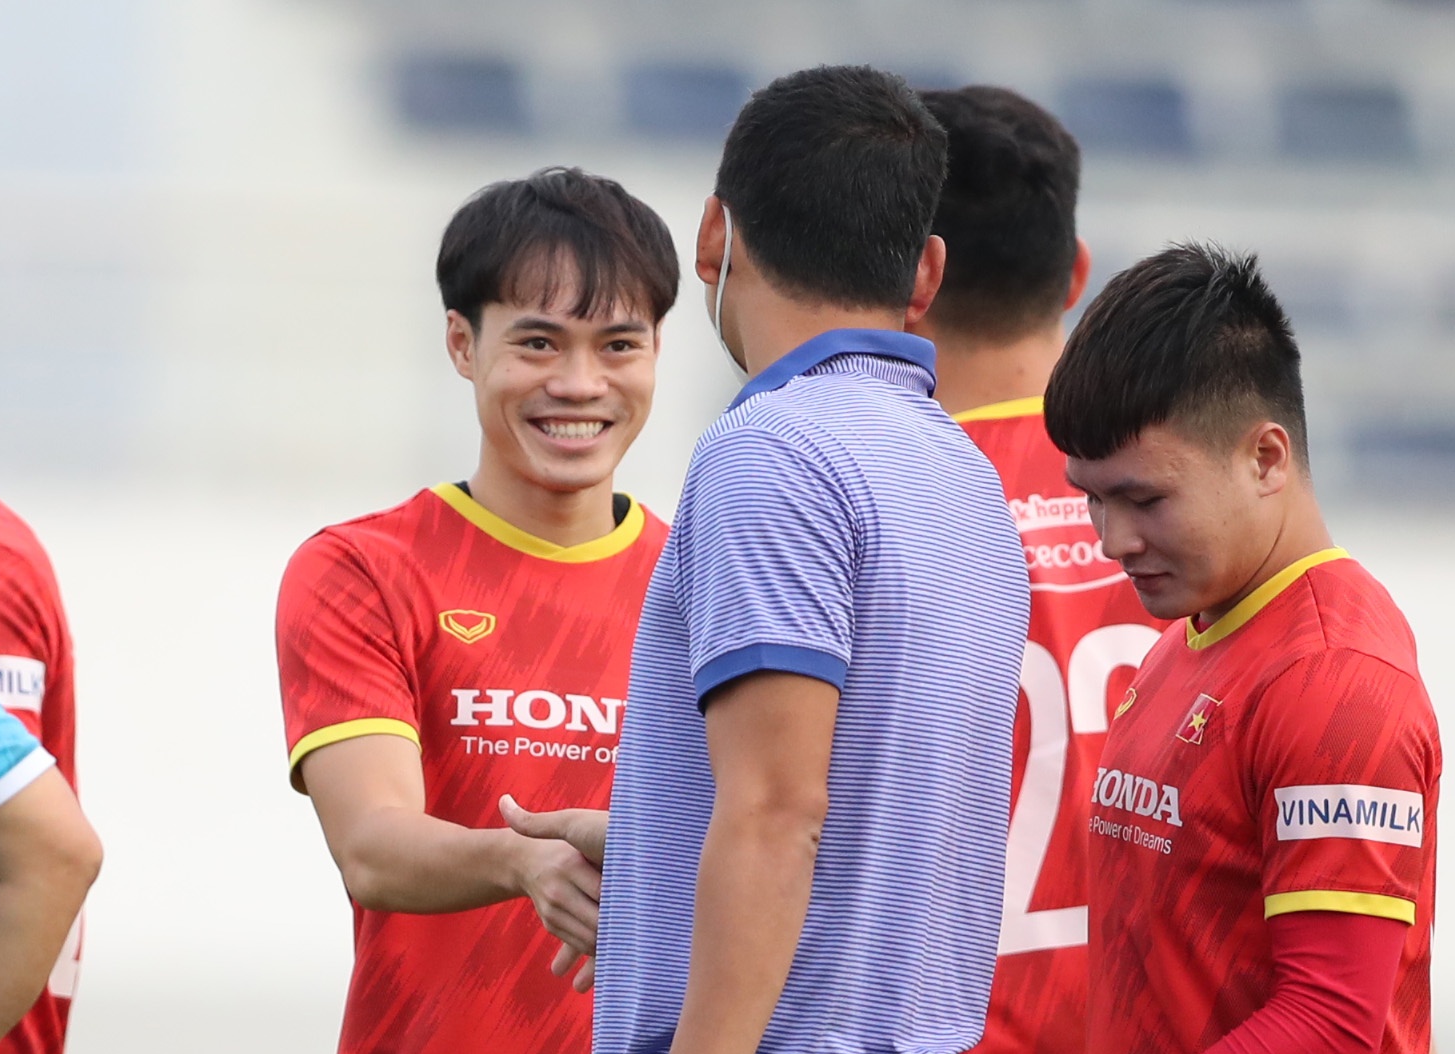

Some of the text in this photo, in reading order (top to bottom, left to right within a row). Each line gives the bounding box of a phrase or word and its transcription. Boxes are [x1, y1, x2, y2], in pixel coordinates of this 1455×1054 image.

[450, 688, 628, 734] HON
[460, 736, 509, 755] The
[514, 737, 591, 761] Power
[1281, 797, 1421, 834] VINAMILK
[1093, 815, 1122, 839] Power
[1122, 824, 1134, 842] of
[1133, 826, 1173, 855] Dreams
